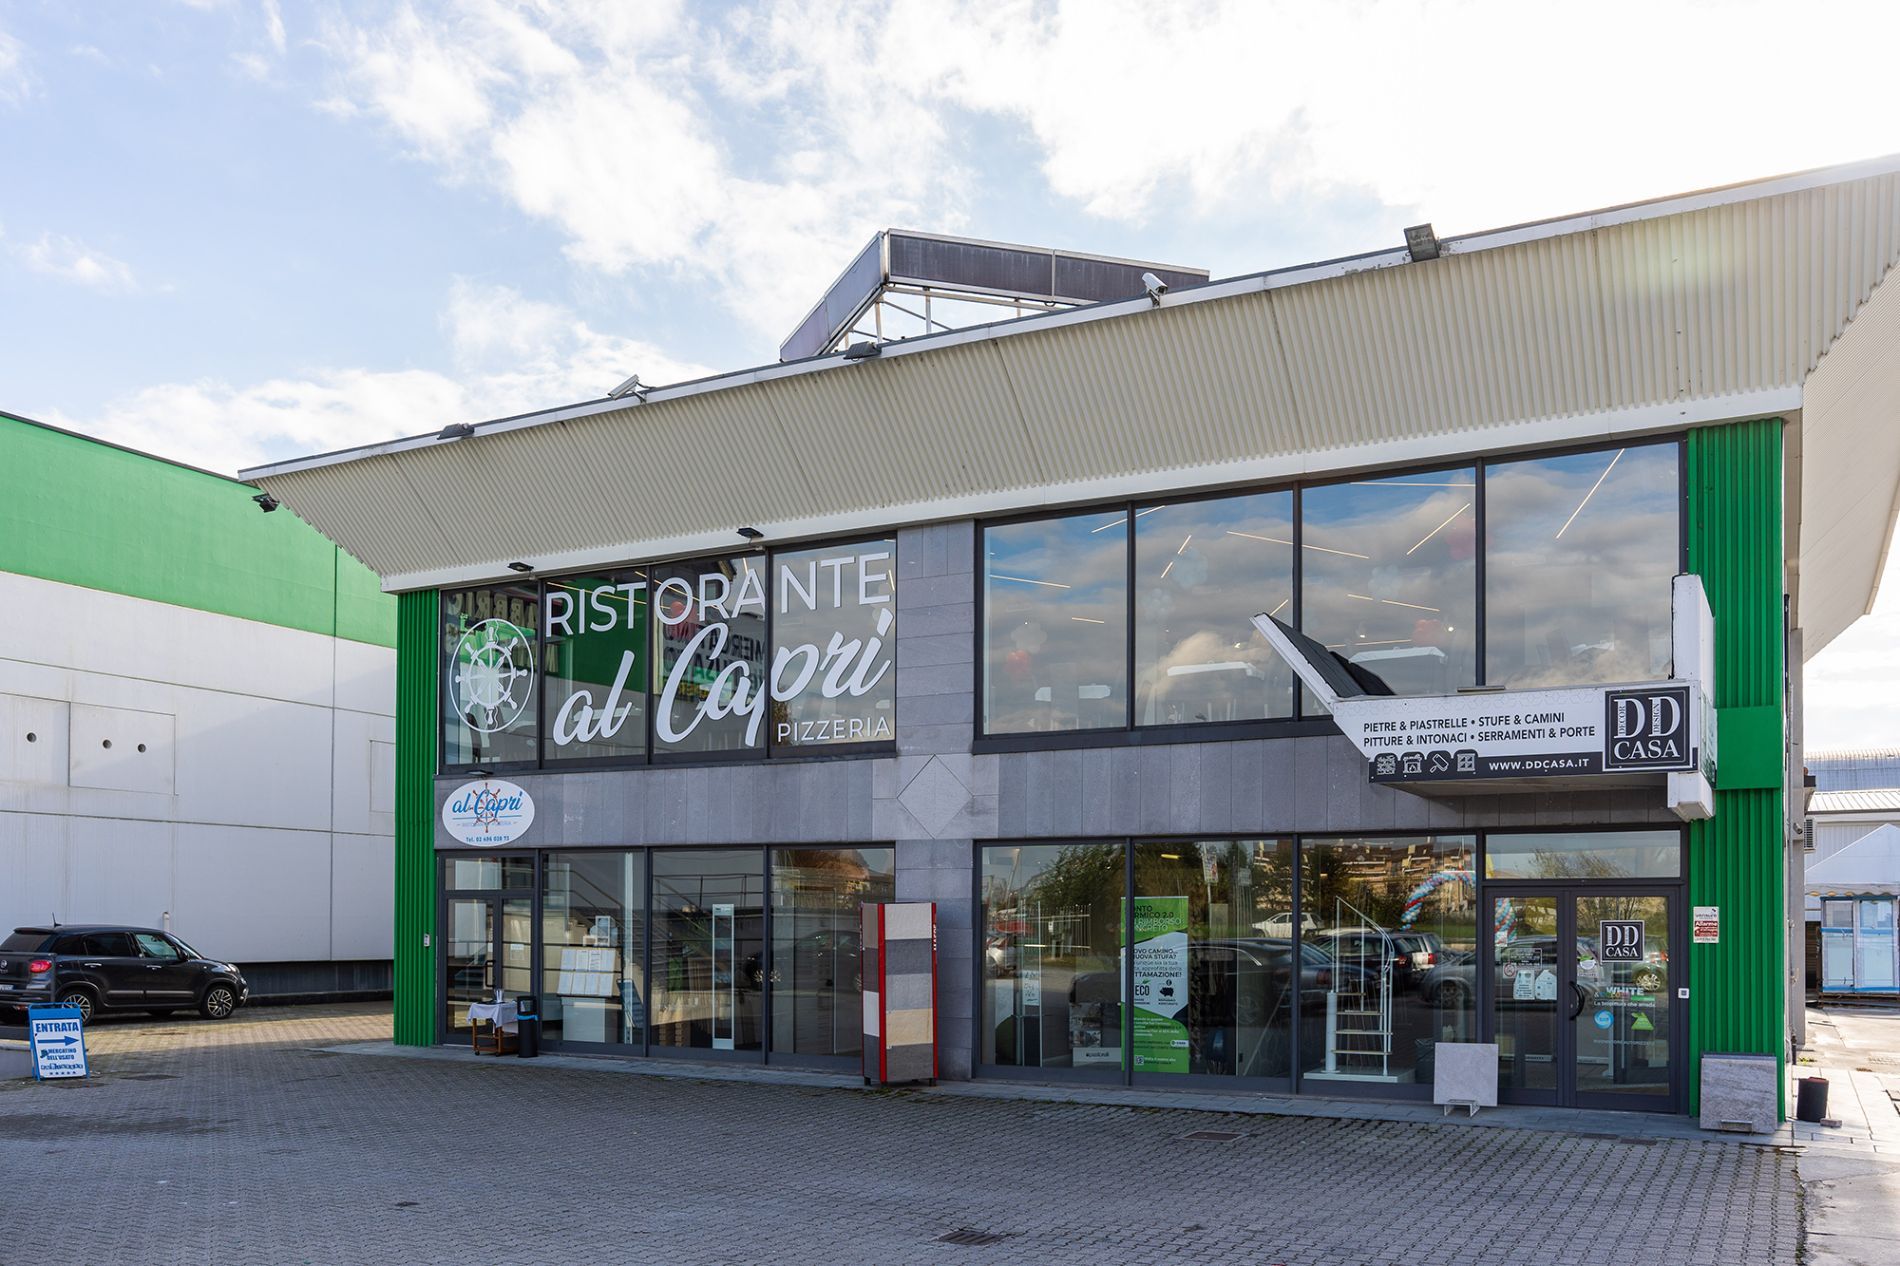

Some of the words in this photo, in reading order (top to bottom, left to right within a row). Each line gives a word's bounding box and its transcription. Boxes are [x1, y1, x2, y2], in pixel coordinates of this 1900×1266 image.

[545, 552, 891, 638] RISTORANTE
[553, 650, 635, 746] al
[656, 608, 895, 747] Capri
[777, 716, 891, 743] PIZZERIA
[1364, 721, 1397, 733] PIETRE
[1400, 720, 1408, 732] &
[1410, 717, 1468, 731] PIASTRELLE
[1478, 714, 1512, 727] STUFE
[1514, 714, 1522, 726] &
[1525, 712, 1565, 726] CAMINI
[1364, 734, 1403, 747] PITTURE
[1405, 734, 1414, 746] &
[1416, 732, 1468, 745] INTONACI
[1478, 728, 1546, 742] SERRAMENTI
[1548, 727, 1557, 739] &
[1560, 725, 1596, 738] PORTE
[1614, 739, 1680, 760] CASA
[1489, 757, 1590, 772] WWW.DDCASA.IT
[452, 793, 472, 814] al
[474, 789, 523, 818] Capri
[1606, 947, 1638, 957] CASA
[1135, 985, 1150, 996] ECO
[1606, 987, 1644, 996] WHITE
[36, 1022, 79, 1032] ENTRATA
